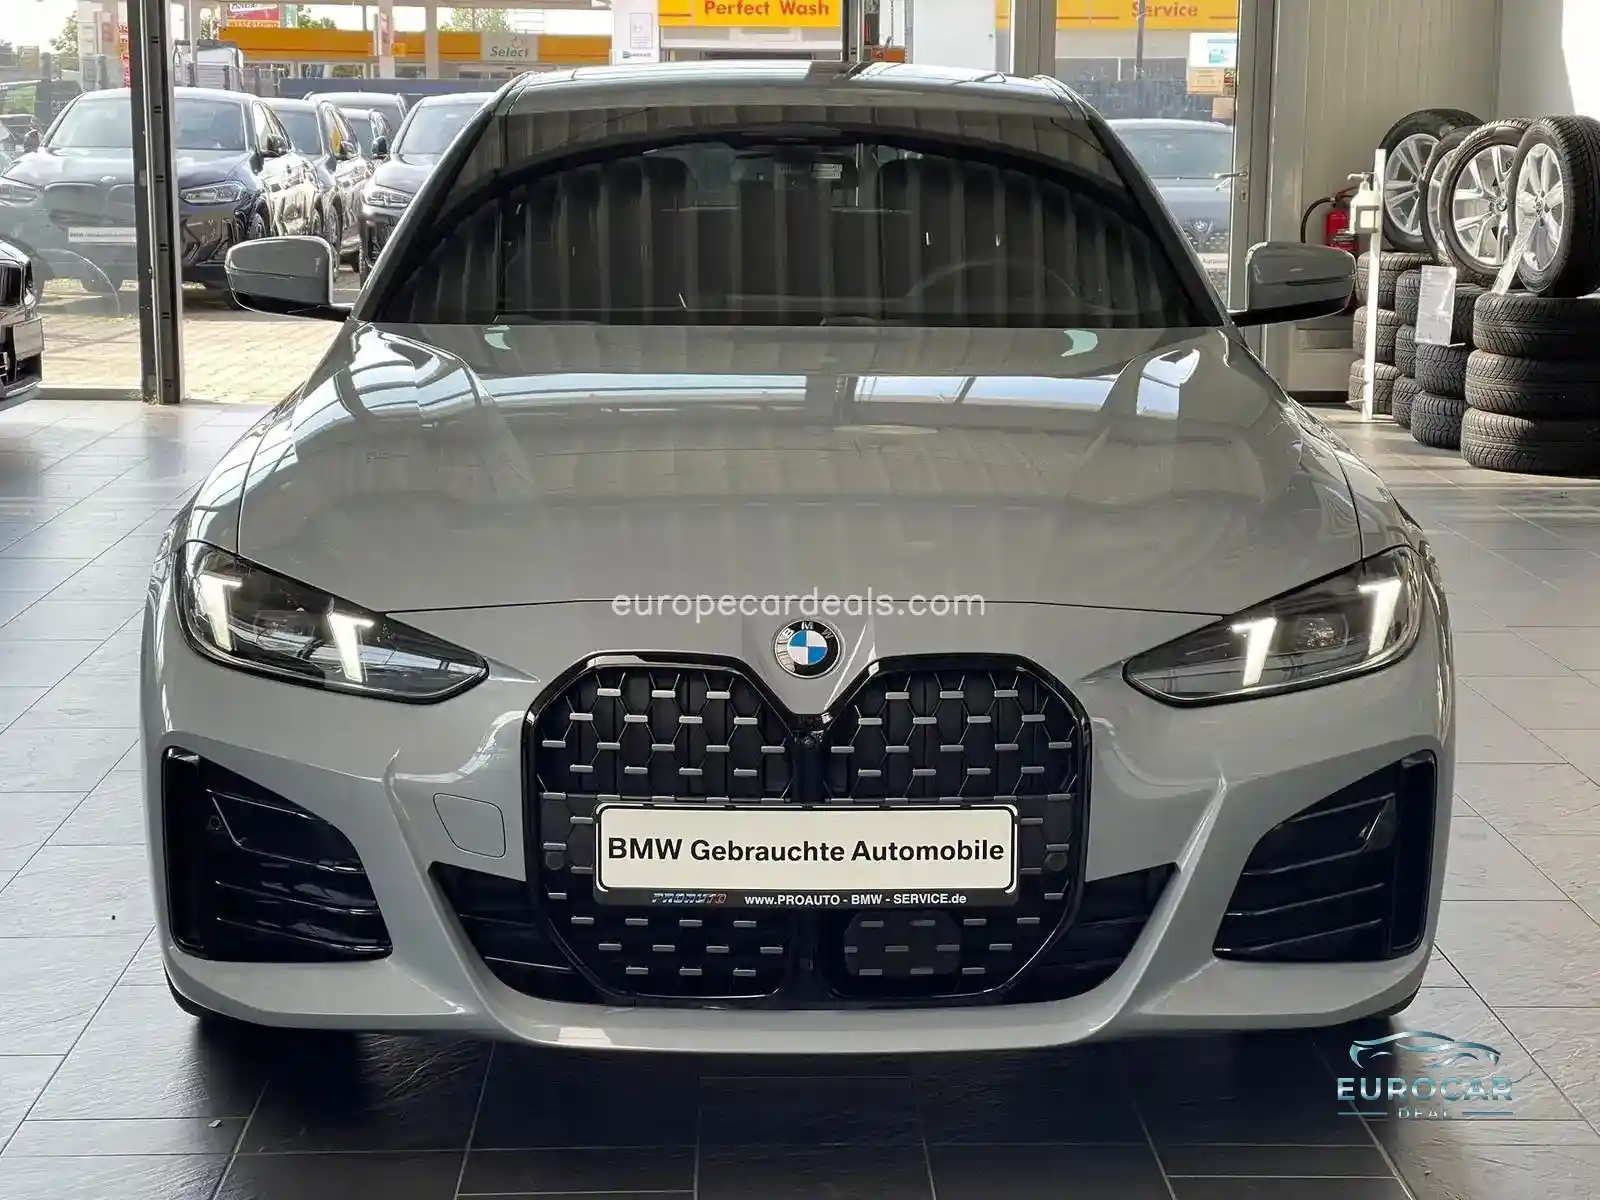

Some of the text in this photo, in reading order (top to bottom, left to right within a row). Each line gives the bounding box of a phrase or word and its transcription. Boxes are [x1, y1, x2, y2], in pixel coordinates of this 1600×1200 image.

[703, 0, 829, 15] Perfect Wash
[1131, 1, 1198, 17] Service
[490, 46, 529, 57] Select
[782, 621, 834, 640] BMW
[608, 837, 1004, 861] BMW Gebrauchte Automobile
[652, 893, 727, 904] PROAUTO
[744, 895, 840, 906] www.PROAUTO
[851, 895, 882, 905] BMW
[893, 893, 967, 905] SERVICE.de
